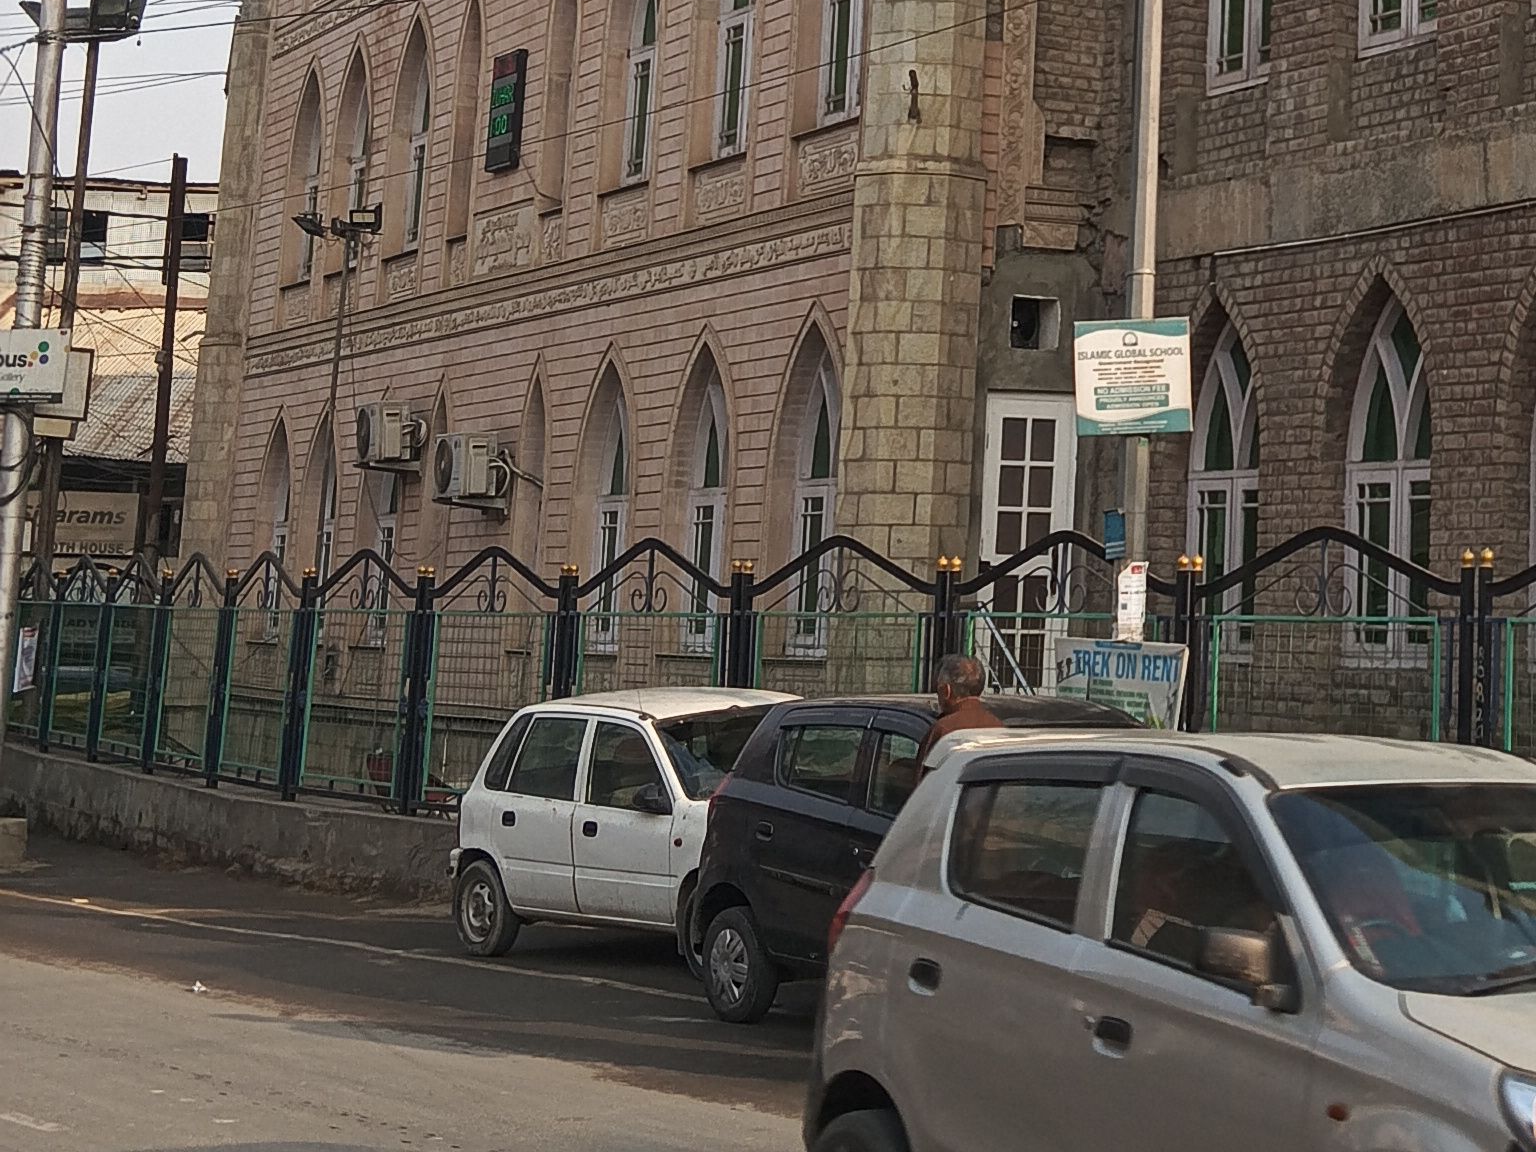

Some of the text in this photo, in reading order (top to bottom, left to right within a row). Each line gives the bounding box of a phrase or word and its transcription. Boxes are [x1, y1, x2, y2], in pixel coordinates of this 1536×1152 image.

[1078, 347, 1183, 360] ISLAMIC GLOBAL SCHOOL
[81, 542, 125, 554] HOUSE
[1073, 650, 1180, 682] TREK ON RENT
